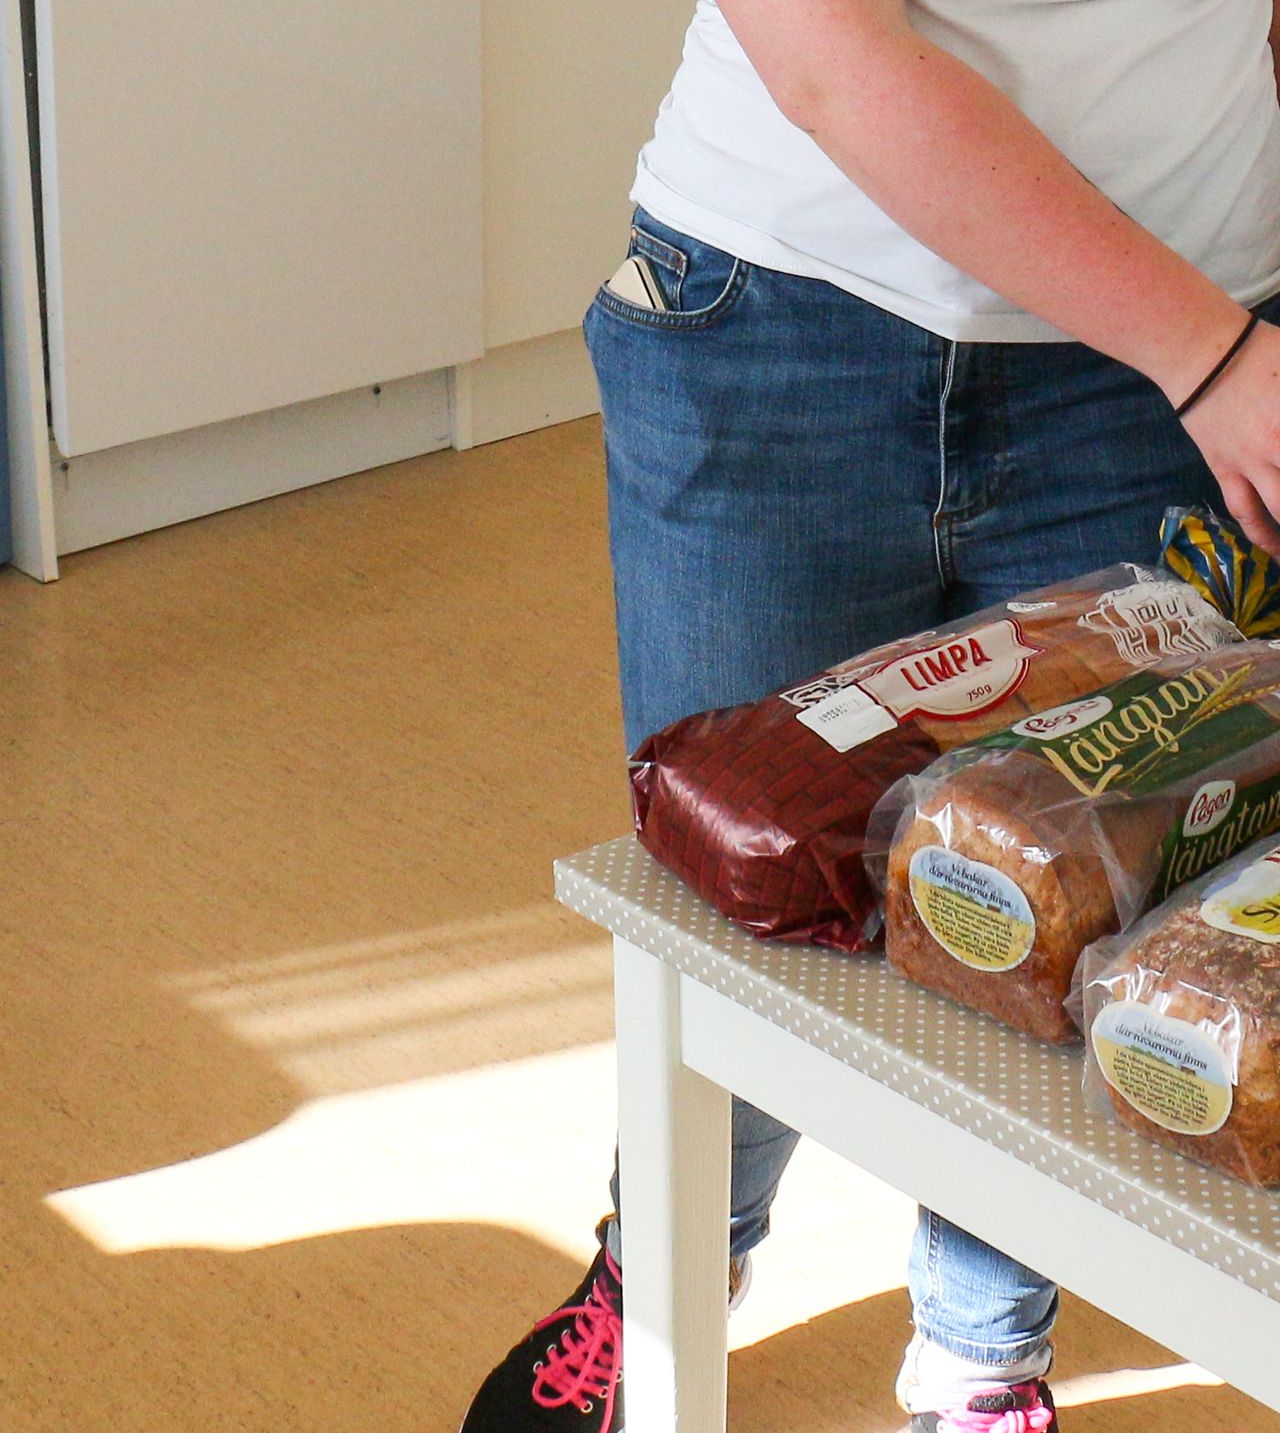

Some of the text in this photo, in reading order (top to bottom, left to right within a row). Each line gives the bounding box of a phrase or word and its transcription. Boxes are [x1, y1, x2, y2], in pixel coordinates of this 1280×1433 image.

[900, 638, 992, 691] LIMPA
[1040, 666, 1228, 798] Längtan
[1189, 789, 1231, 826] Pågen
